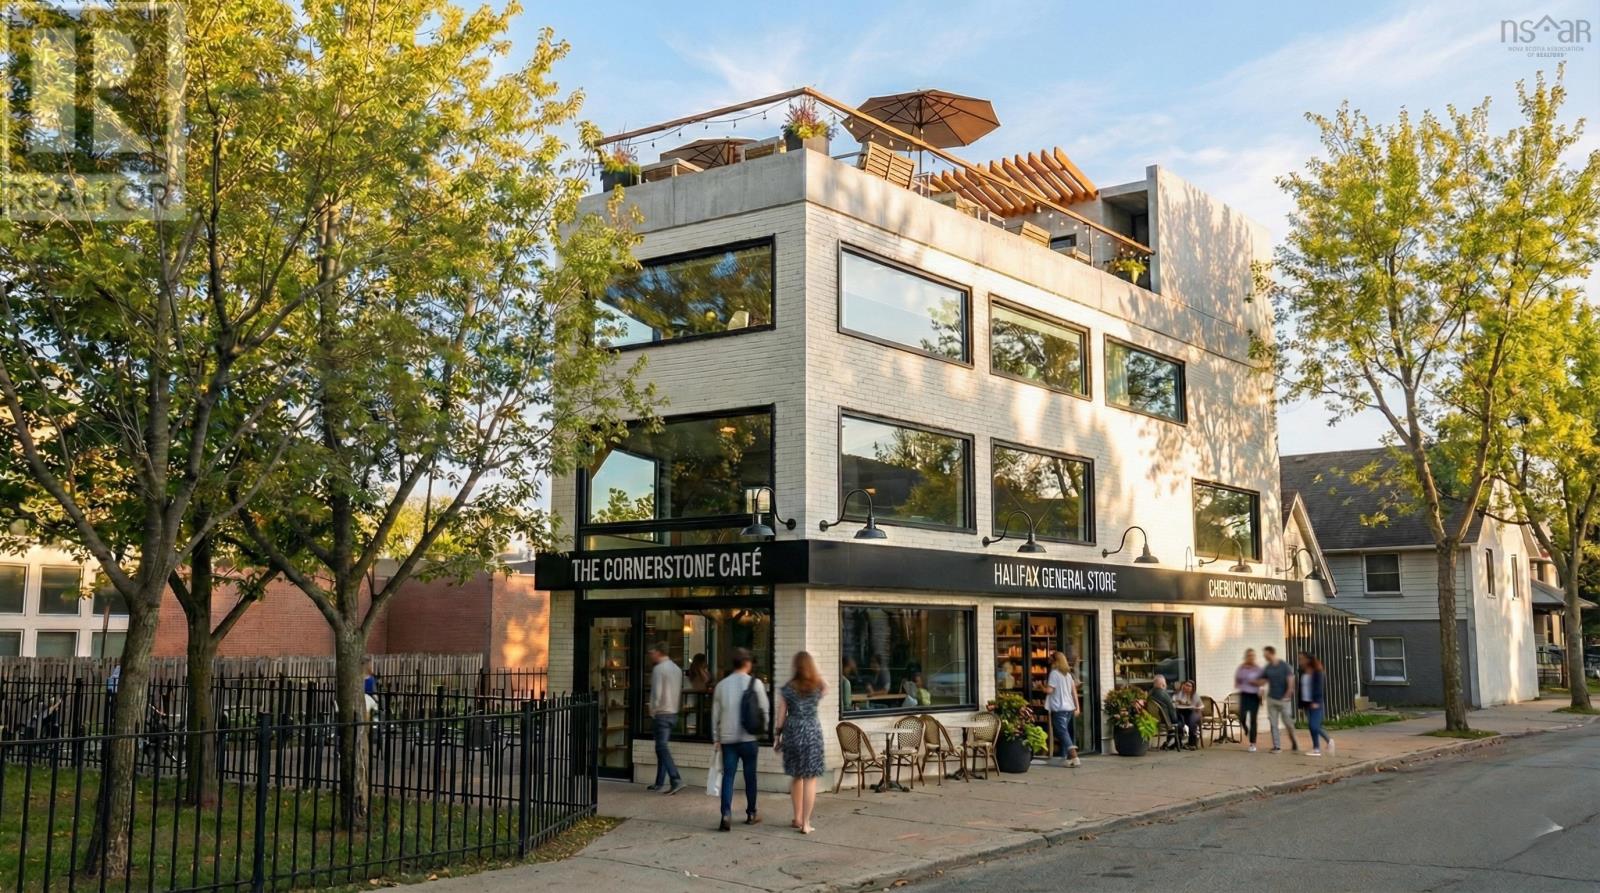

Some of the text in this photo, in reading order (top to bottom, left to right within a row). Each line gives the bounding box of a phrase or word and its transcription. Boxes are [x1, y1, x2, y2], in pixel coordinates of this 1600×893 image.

[572, 547, 762, 582] THE CORNERSTONE CAFÉ
[994, 563, 1117, 592] HALIFAX GENERAL STORE
[1208, 579, 1287, 601] CHEBUCTO COWORKING
